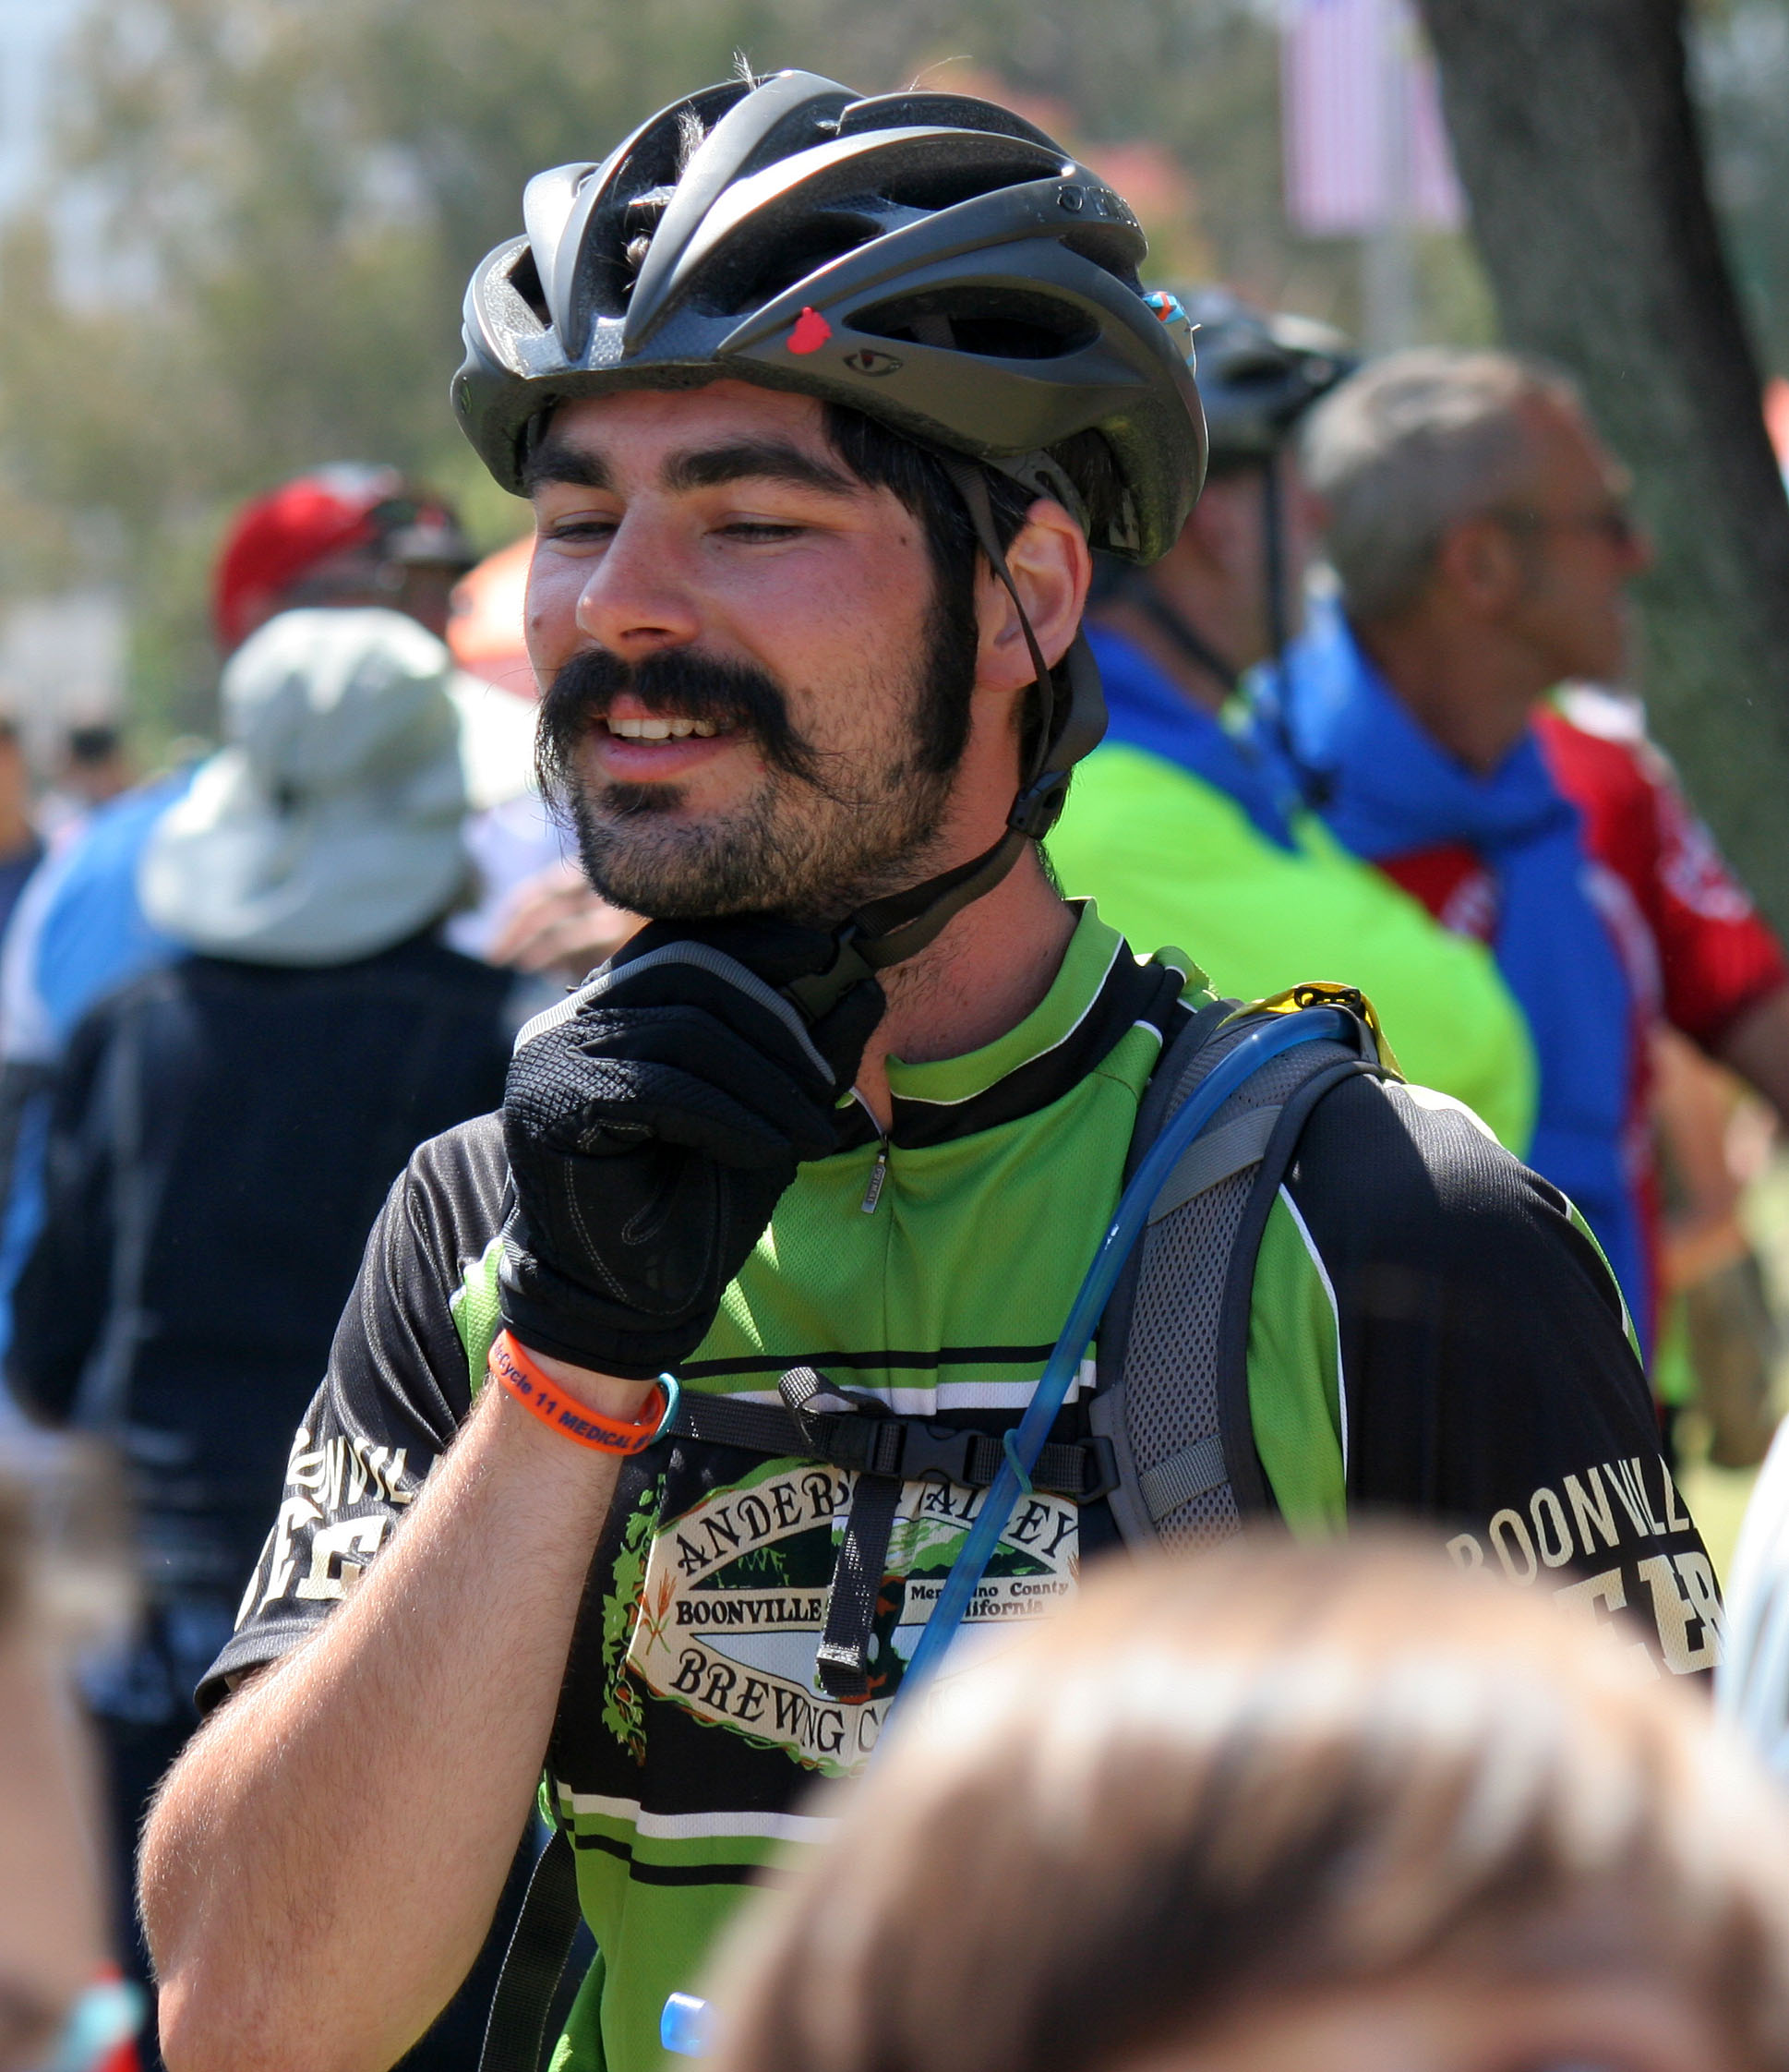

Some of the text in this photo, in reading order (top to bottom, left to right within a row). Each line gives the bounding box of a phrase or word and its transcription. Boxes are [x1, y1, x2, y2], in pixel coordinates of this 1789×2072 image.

[534, 1392, 558, 1415] 11
[558, 1410, 631, 1449] MEDICAL
[1010, 1581, 1069, 1596] County
[676, 1597, 822, 1625] BOONVILLE
[965, 1597, 1043, 1618] lifornia
